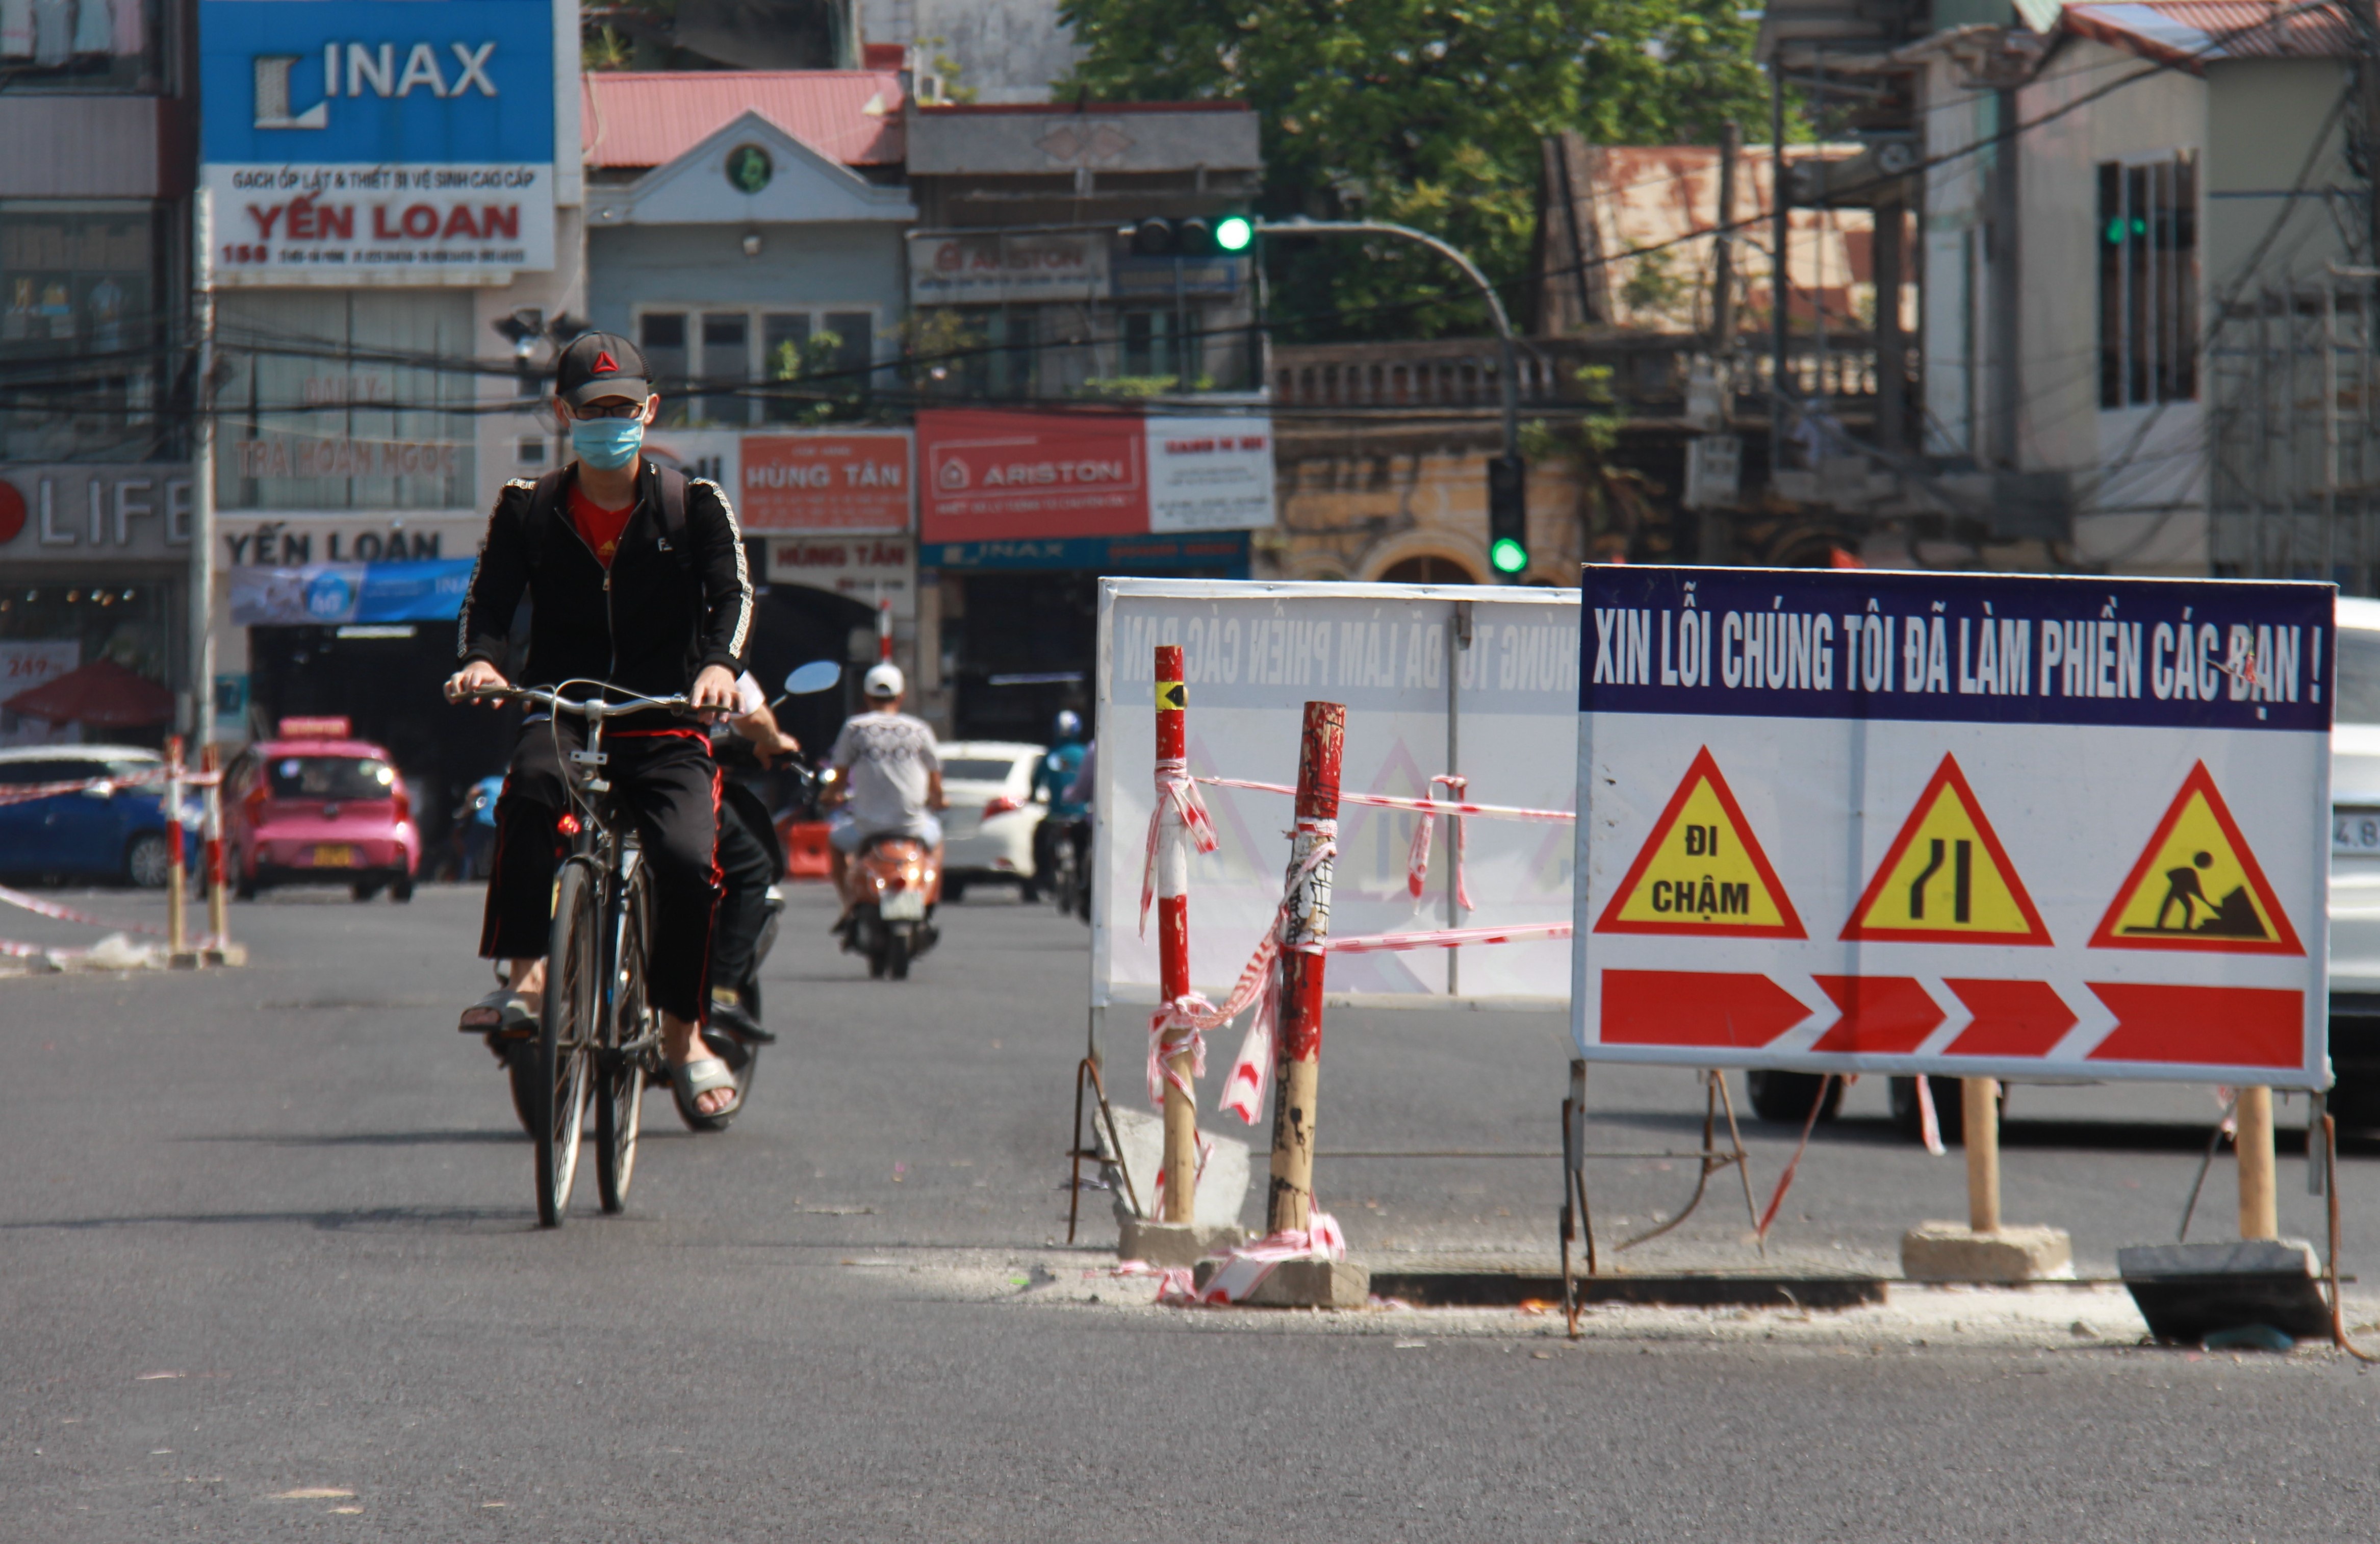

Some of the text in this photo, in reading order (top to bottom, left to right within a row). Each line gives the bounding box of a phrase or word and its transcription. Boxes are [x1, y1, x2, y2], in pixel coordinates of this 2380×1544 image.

[323, 42, 498, 97] INAX
[335, 171, 345, 189] &
[435, 170, 468, 189] SINH
[247, 191, 520, 241] YẾN LOAN
[982, 461, 1123, 487] ARISTON
[224, 520, 441, 565] YẾN LOAN
[979, 543, 1064, 558] INAX
[1593, 581, 2322, 720] XIN LỖI CHÚNG TÔI ĐÃ LÀM PHIỀN CÁC BẠN !
[1685, 824, 1718, 857] ĐI
[1652, 875, 1750, 922] CHẬM
